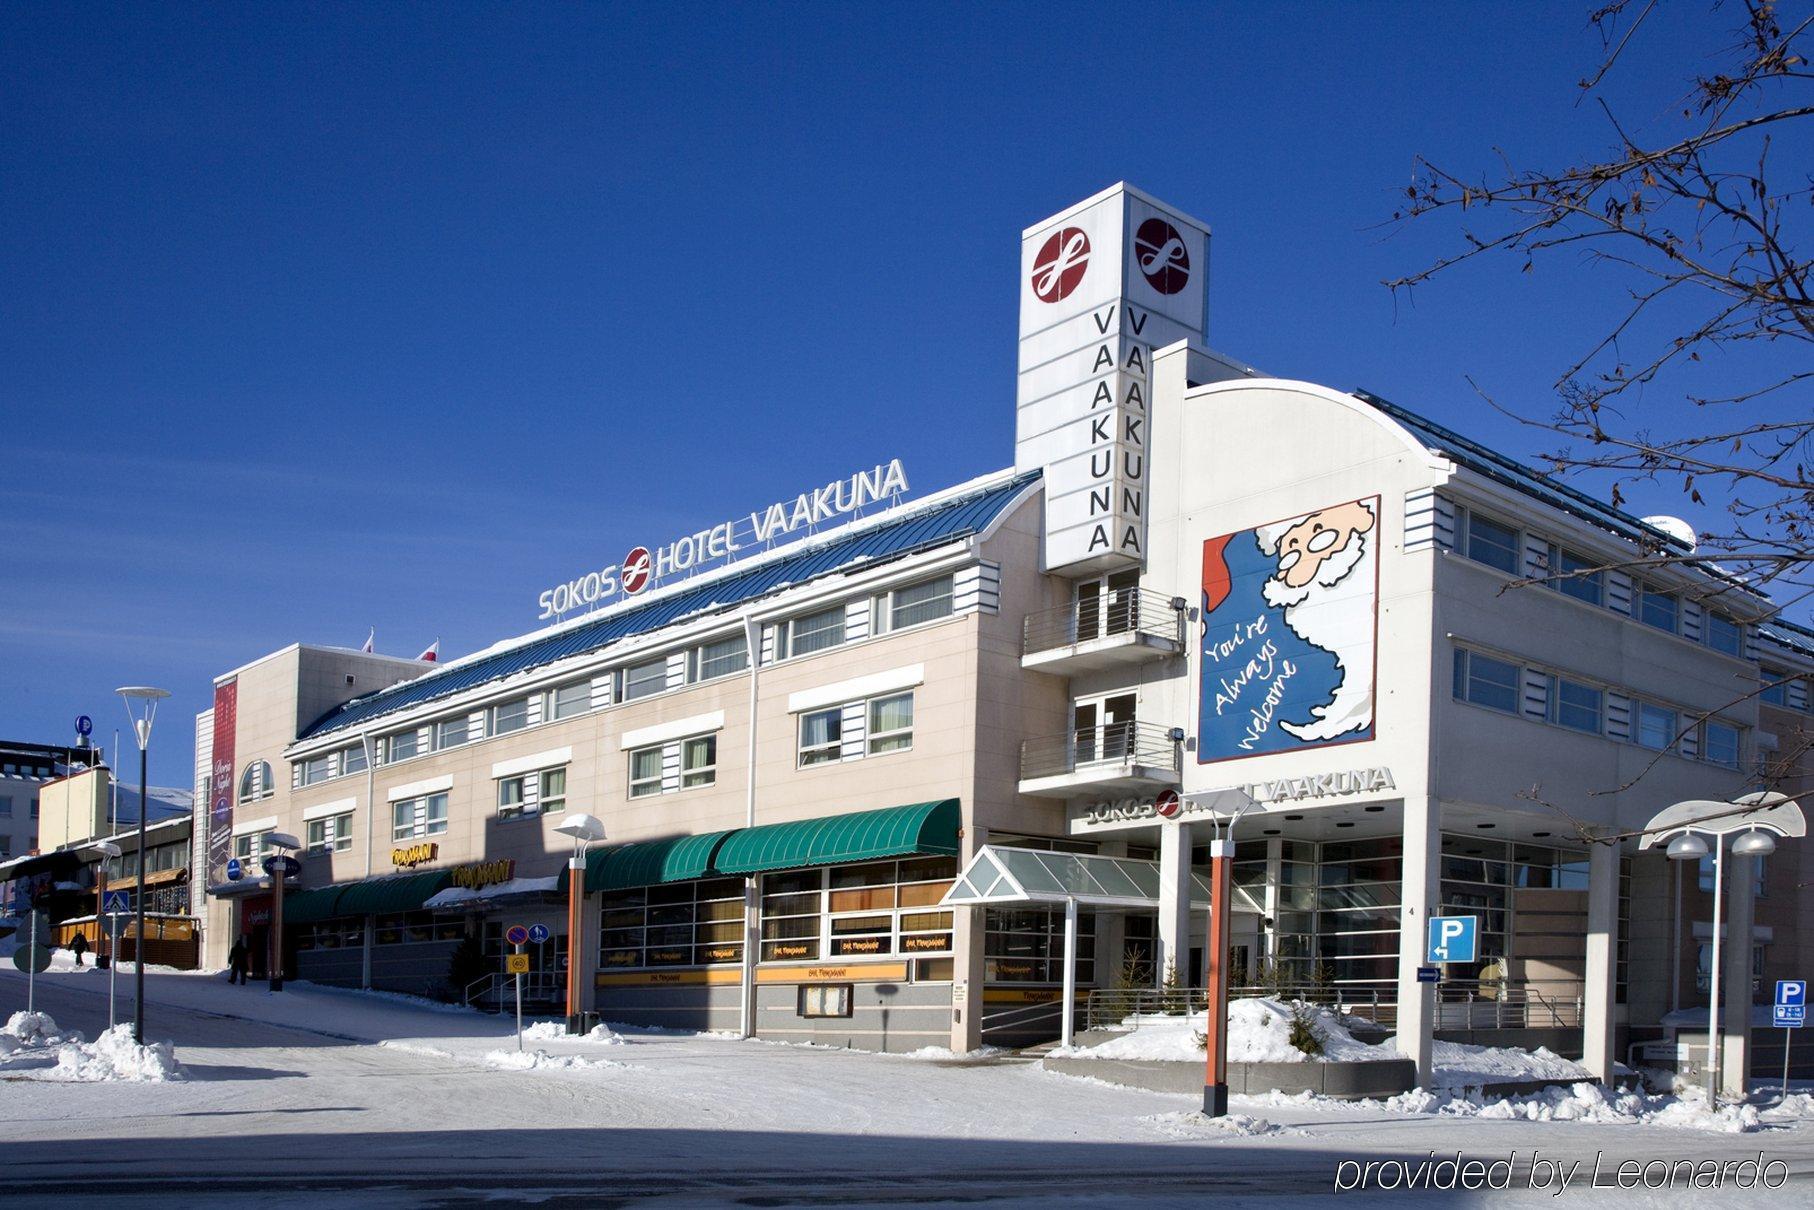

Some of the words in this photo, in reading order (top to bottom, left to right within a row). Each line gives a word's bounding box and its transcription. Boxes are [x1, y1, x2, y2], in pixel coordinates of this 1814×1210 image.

[1088, 305, 1116, 553] VAAKUNA
[1121, 306, 1147, 554] VAAKUNA
[538, 565, 618, 620] SOKOS
[655, 521, 742, 578] HOTEL
[750, 458, 910, 542] VAAKUNA
[1204, 614, 1268, 663] You're
[1215, 638, 1278, 716] Always
[1262, 767, 1395, 802] VAAKUNA
[1408, 907, 1415, 916] 4
[1441, 920, 1464, 948] P
[1781, 983, 1802, 1004] P
